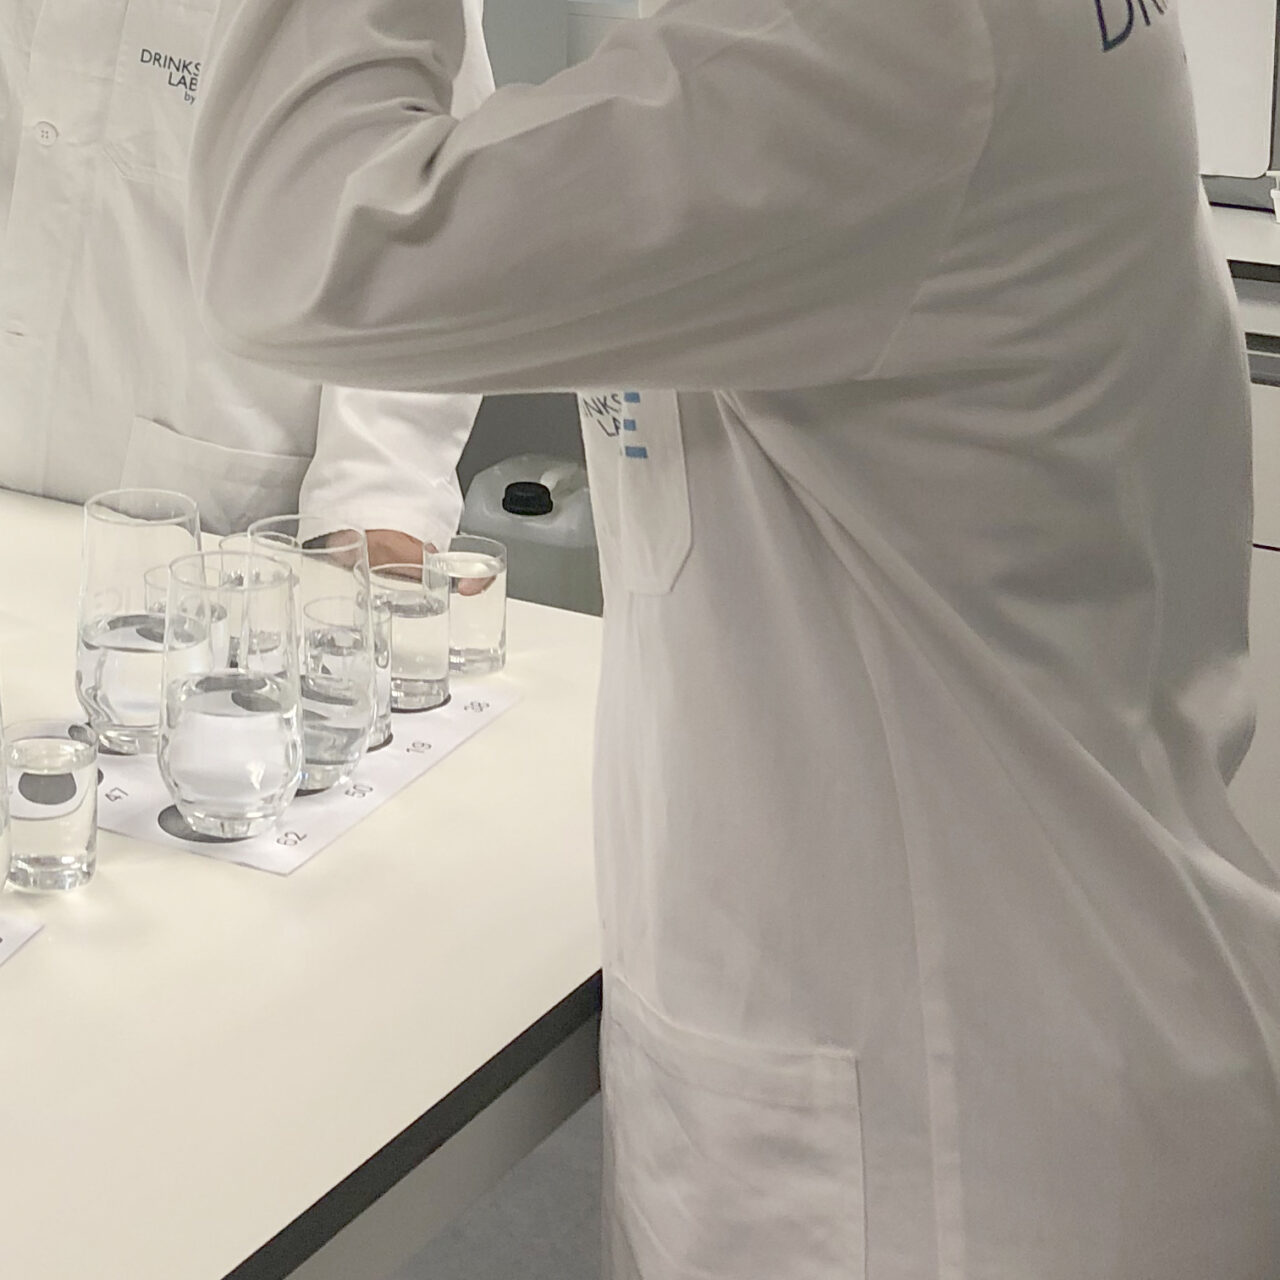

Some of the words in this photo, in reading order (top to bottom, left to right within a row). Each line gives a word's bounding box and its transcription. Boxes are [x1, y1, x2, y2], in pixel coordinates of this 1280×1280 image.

[140, 48, 201, 77] DRINKS
[184, 91, 195, 105] by
[344, 784, 373, 798] 50
[276, 831, 307, 846] 62
